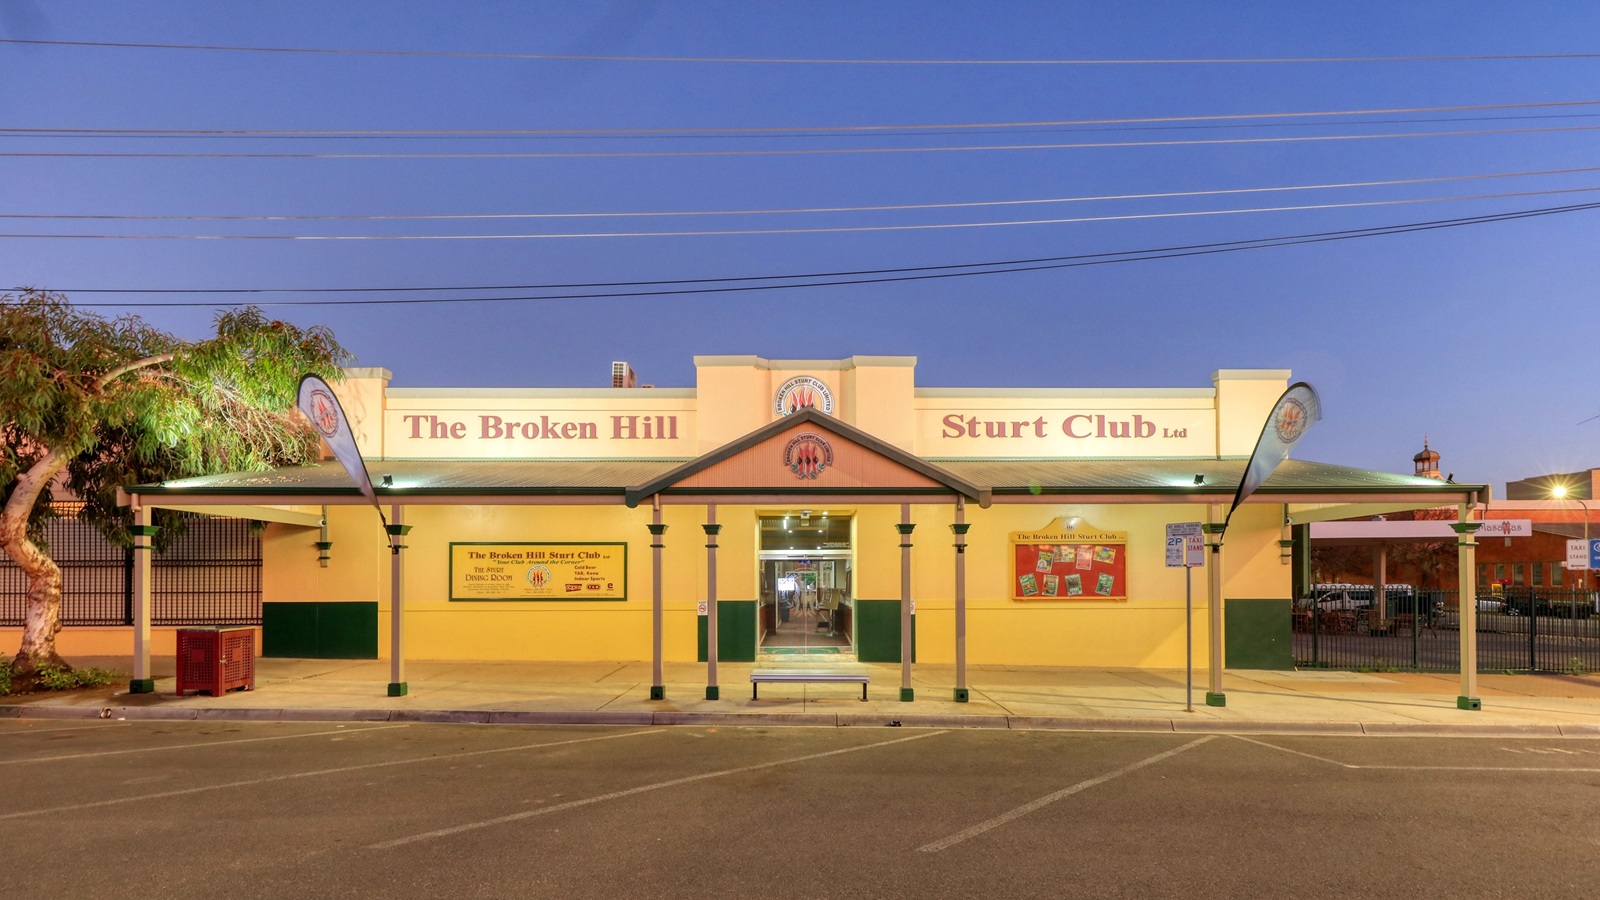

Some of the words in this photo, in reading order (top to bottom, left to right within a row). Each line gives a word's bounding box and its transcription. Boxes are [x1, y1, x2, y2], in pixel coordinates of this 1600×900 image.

[784, 382, 794, 391] HILL
[812, 380, 824, 391] CLUB
[822, 390, 830, 411] LIMITED
[403, 415, 466, 439] The
[478, 415, 598, 440] Broken
[610, 415, 679, 440] Hill
[942, 414, 1048, 438] Sturt
[1062, 414, 1156, 438] Club
[1162, 428, 1188, 438] Ltd
[816, 436, 826, 446] CLUB
